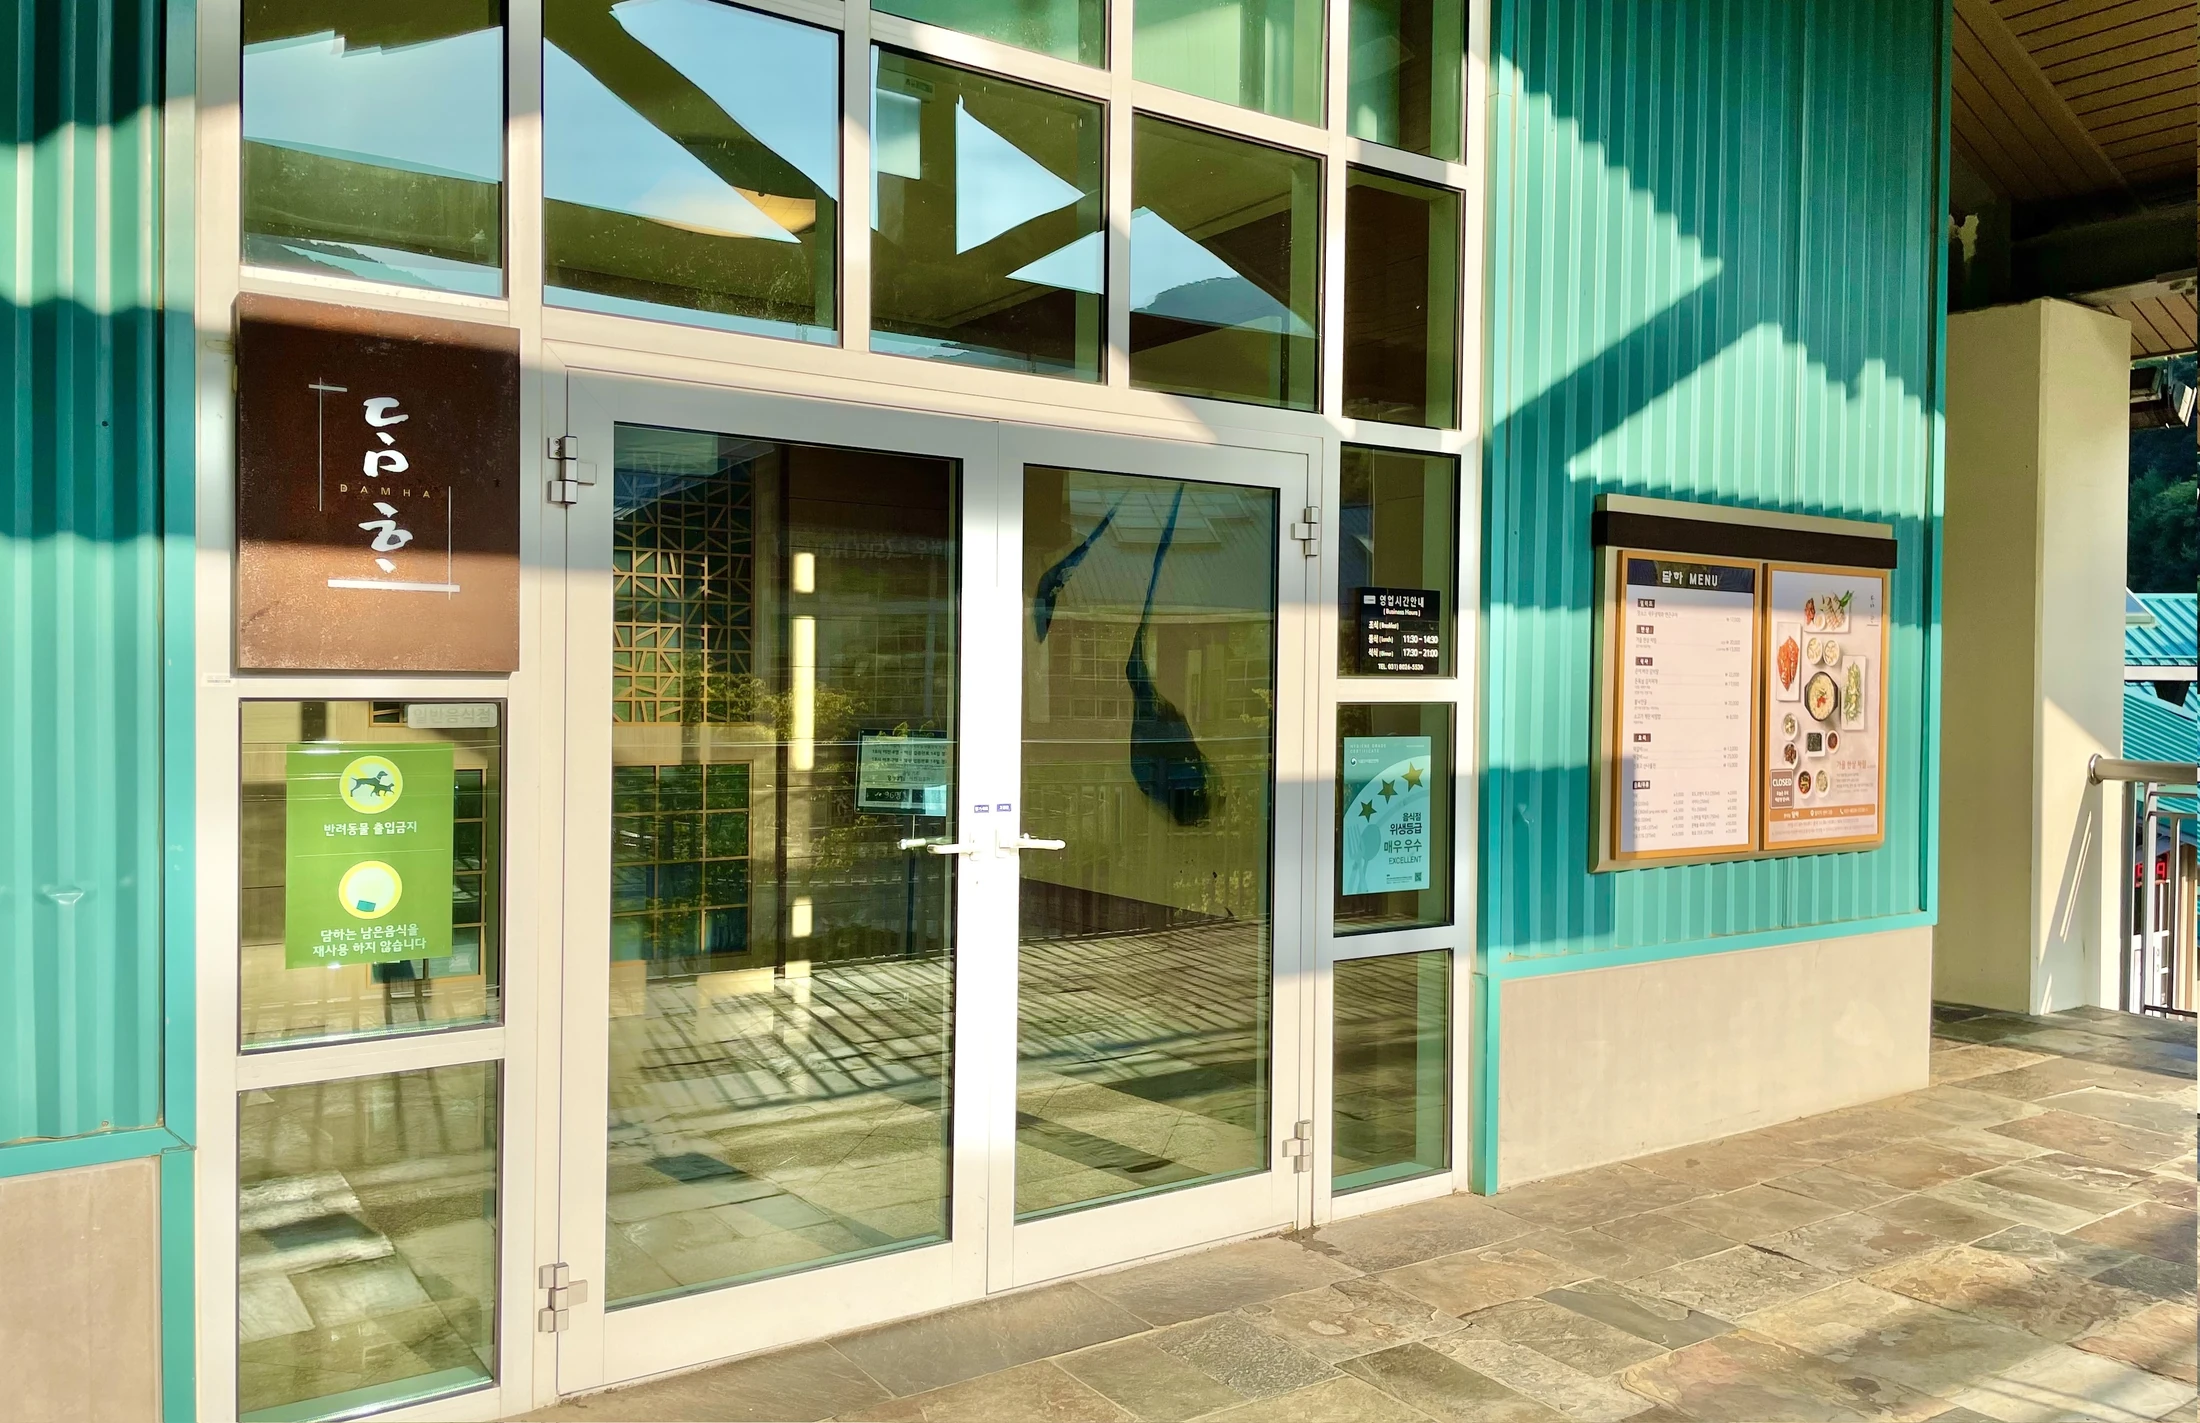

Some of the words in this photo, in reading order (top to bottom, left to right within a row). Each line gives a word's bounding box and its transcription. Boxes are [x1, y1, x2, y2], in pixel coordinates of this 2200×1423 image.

[340, 484, 430, 498] DAMHA
[1662, 570, 1684, 584] 담하
[1690, 572, 1718, 586] MENU
[1380, 594, 1424, 608] 영업시간안내
[1403, 634, 1418, 644] 11:30
[1403, 648, 1418, 657] 17:30
[1423, 649, 1439, 658] 21:00
[414, 708, 490, 724] 일반음식점
[1772, 778, 1792, 787] CLOSED
[1403, 812, 1422, 822] 음식점
[324, 822, 369, 837] 반려동물
[373, 820, 418, 836] 출입금지
[1390, 823, 1422, 836] 위생등급
[1384, 840, 1402, 854] 매우
[1404, 838, 1422, 852] 우수
[1389, 855, 1422, 865] EXCELLENT
[320, 928, 356, 943] 담하는
[360, 923, 419, 940] 남은음식을
[312, 943, 349, 958] 재사용
[353, 941, 376, 954] 하지
[380, 937, 426, 954] 않습니다
